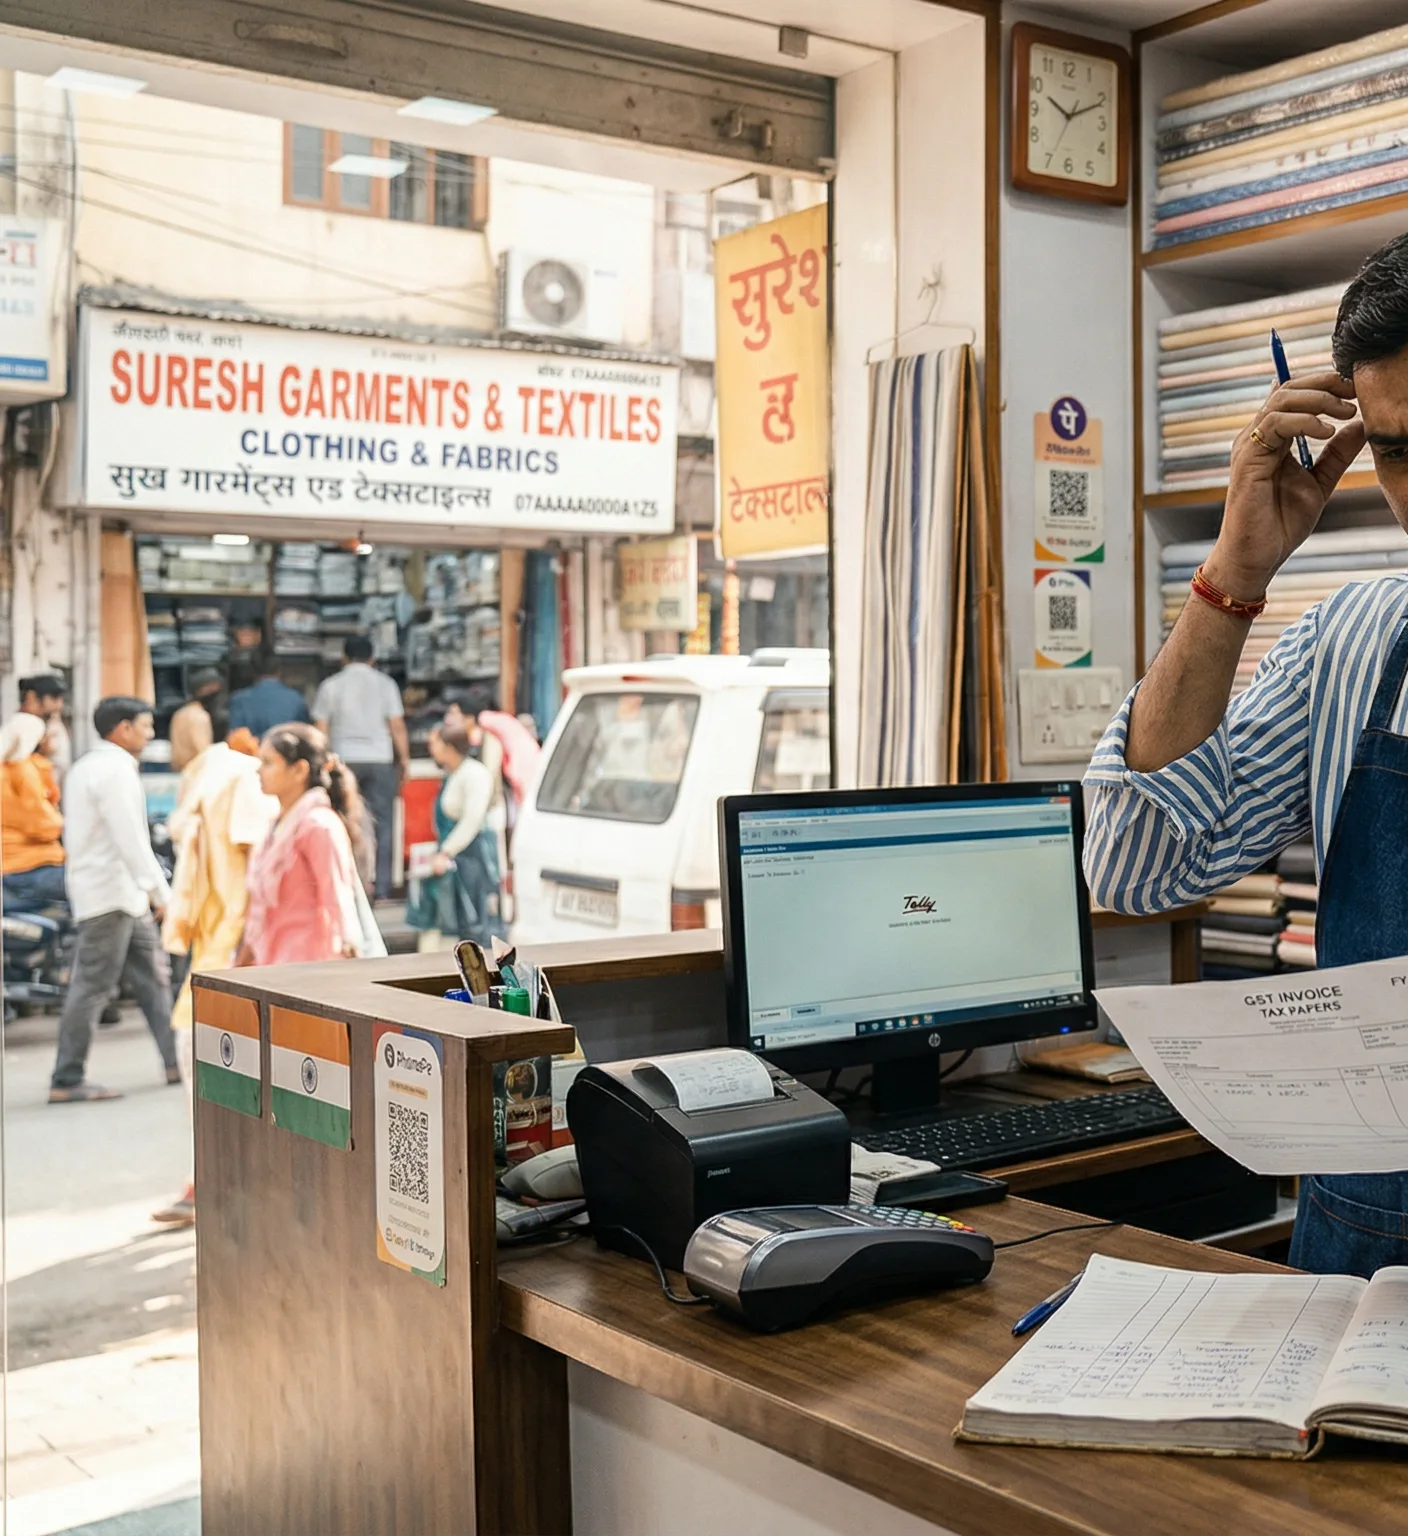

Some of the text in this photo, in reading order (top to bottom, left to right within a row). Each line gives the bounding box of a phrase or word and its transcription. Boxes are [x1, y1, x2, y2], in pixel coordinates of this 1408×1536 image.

[1043, 55, 1054, 74] 11
[1063, 61, 1076, 79] 12
[1031, 76, 1043, 94] 10
[1031, 101, 1039, 117] 9
[1097, 92, 1106, 109] 2
[1097, 116, 1106, 132] 3
[1031, 126, 1039, 143] 8
[1097, 141, 1106, 156] 4
[1044, 153, 1053, 169] 7
[1063, 157, 1073, 174] 6
[1085, 160, 1095, 177] 5
[110, 348, 265, 414] SURESH
[279, 363, 470, 430] GARMENTS
[483, 382, 504, 433] &
[517, 386, 662, 444] TEXTILES
[240, 429, 560, 475] CLOTHING & FABRICS
[108, 463, 168, 500] सुख
[1390, 976, 1407, 987] FY
[1278, 985, 1344, 1004] INVOICE
[1259, 1000, 1343, 1019] TAX PAPERS
